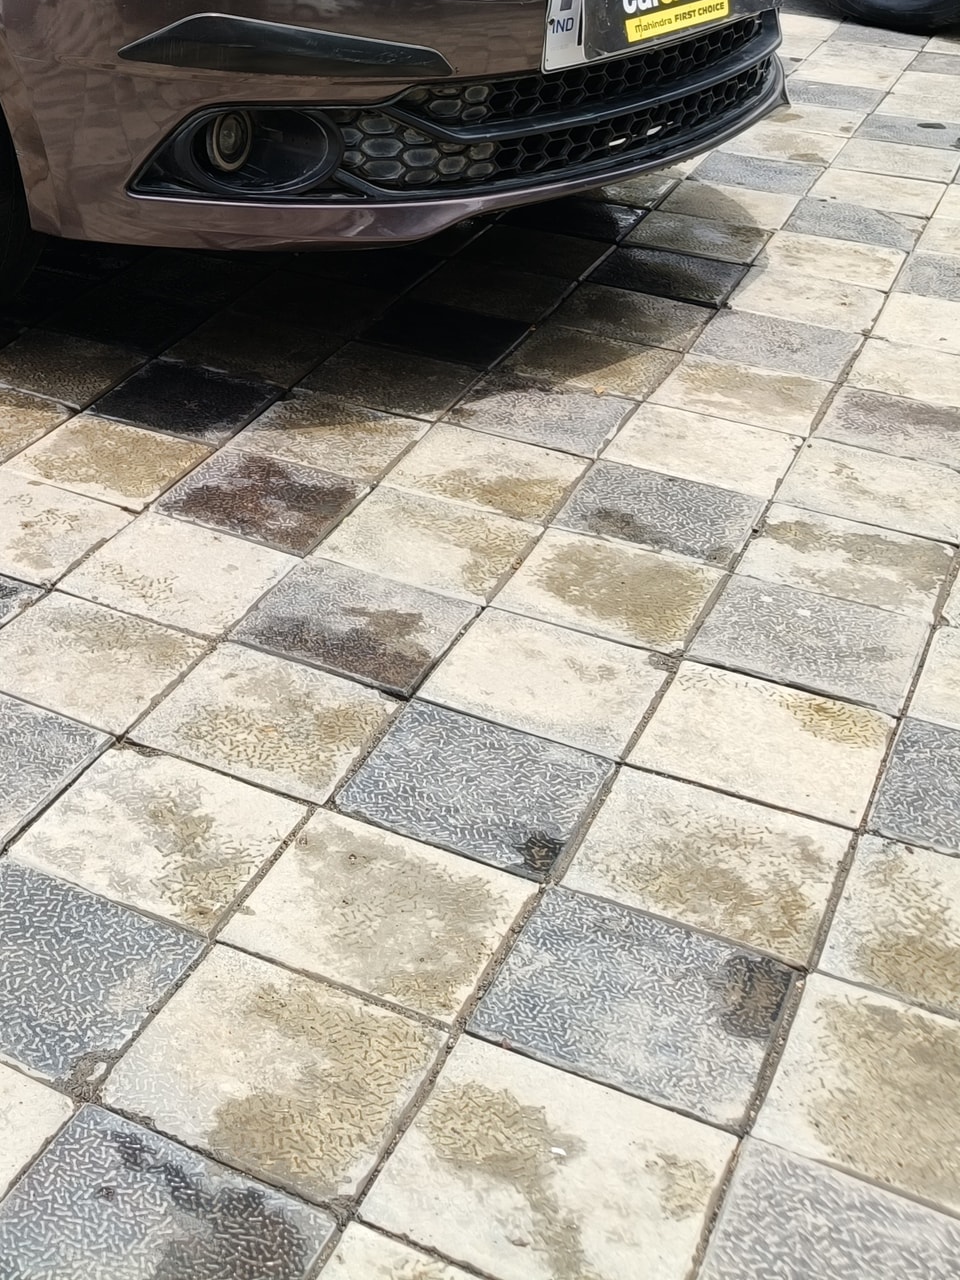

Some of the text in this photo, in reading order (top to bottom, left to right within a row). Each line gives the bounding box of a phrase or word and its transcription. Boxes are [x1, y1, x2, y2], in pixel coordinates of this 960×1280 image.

[551, 17, 574, 34] IND
[635, 1, 725, 33] Mahindra FIRST CHOICE
